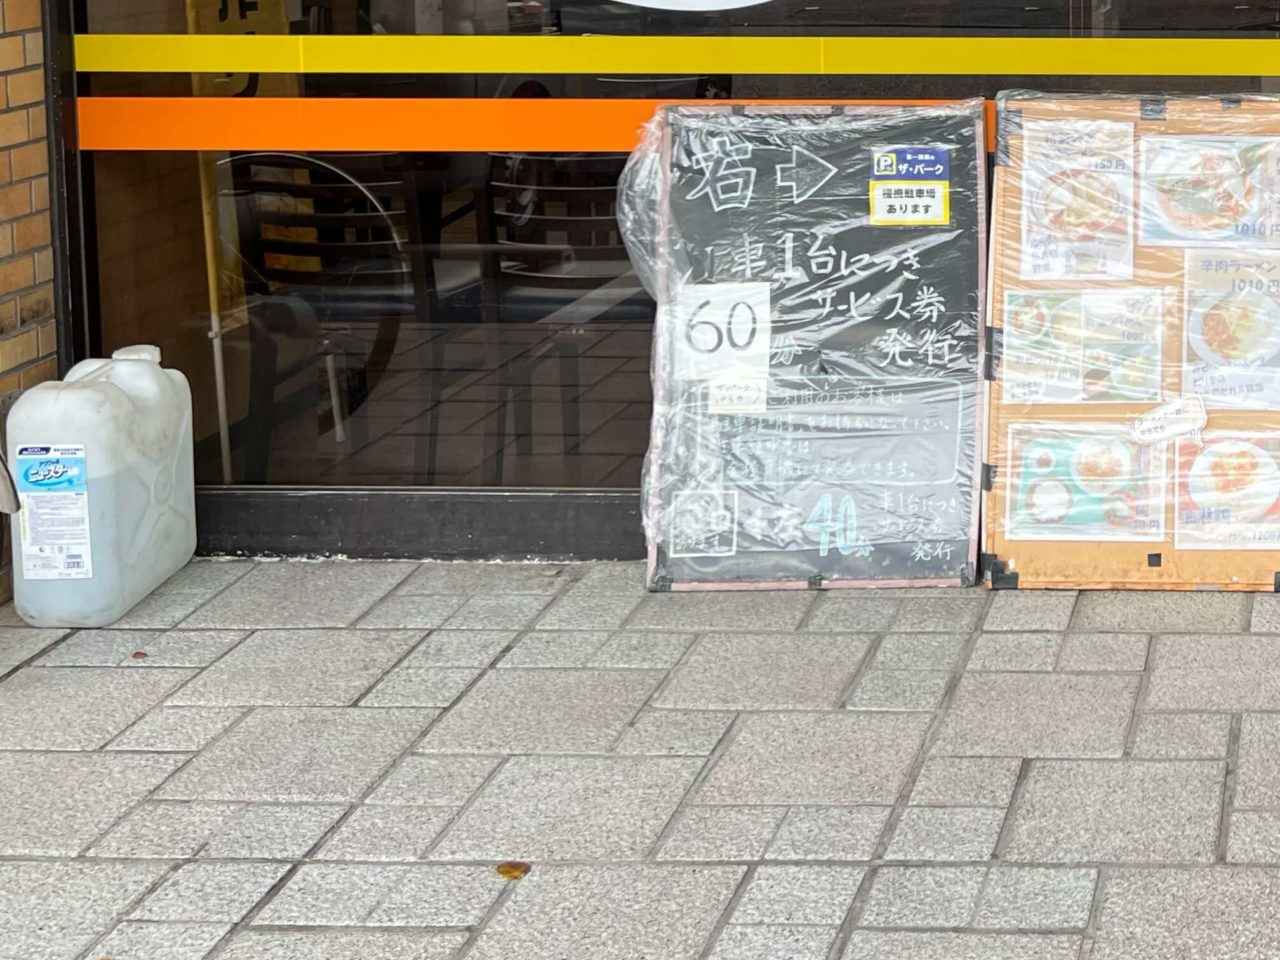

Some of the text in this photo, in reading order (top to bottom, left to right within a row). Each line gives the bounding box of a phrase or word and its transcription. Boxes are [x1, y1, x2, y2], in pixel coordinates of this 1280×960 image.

[886, 204, 932, 214] あります
[1231, 278, 1280, 292] 1010円
[684, 298, 759, 357] 60
[910, 540, 956, 562] 発行
